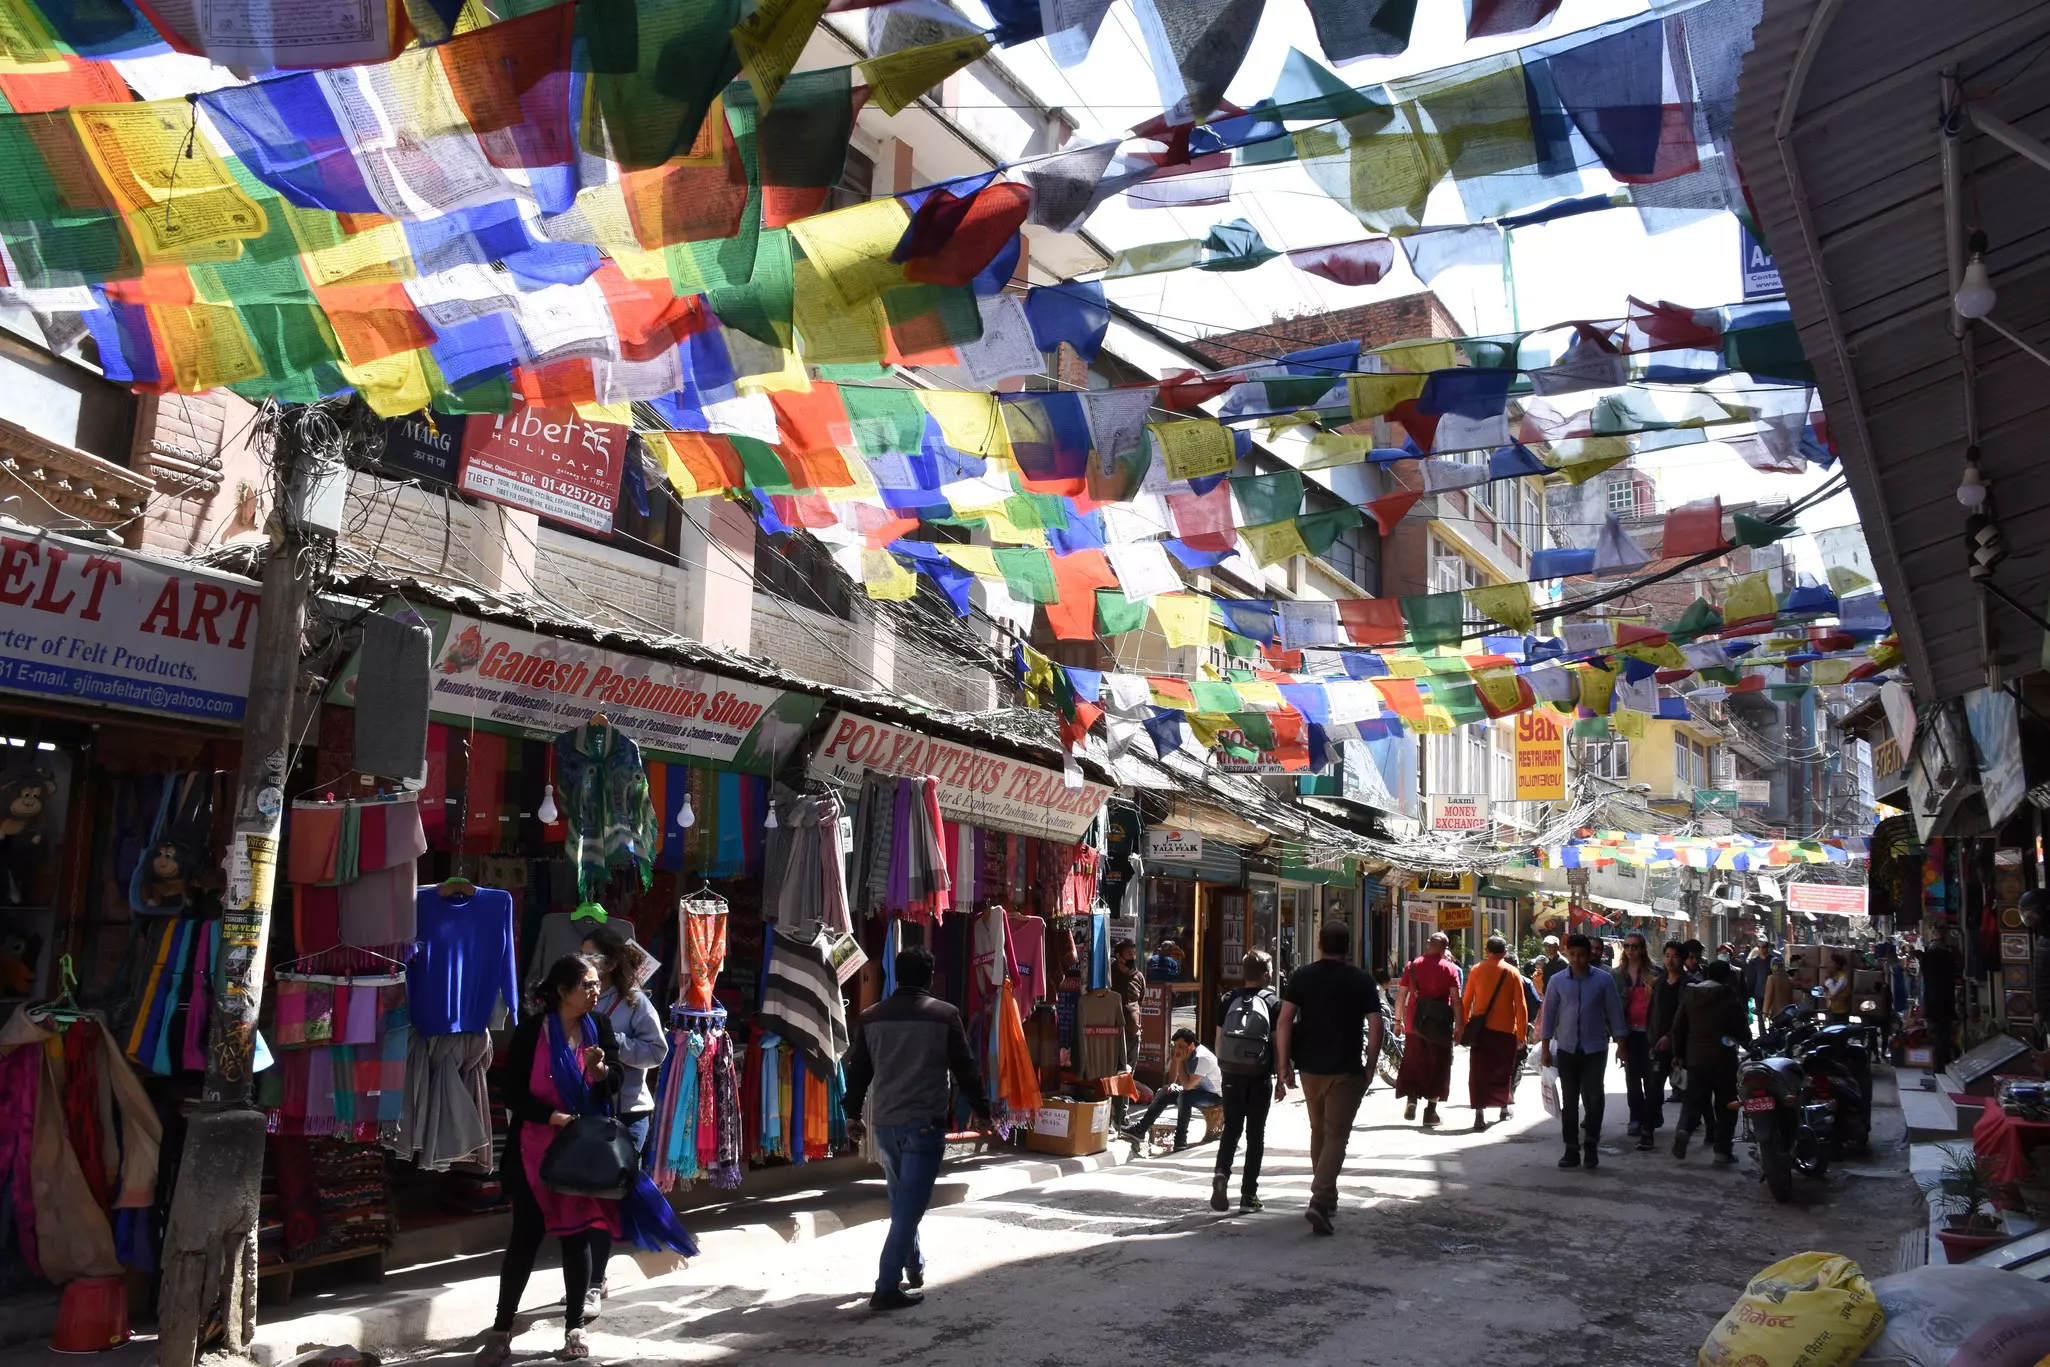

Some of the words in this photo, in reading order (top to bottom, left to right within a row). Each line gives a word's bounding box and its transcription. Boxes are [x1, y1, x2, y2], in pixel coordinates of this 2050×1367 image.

[492, 432, 604, 476] HOLIDAYS
[467, 471, 495, 487] TIBET
[521, 471, 536, 485] Tel:
[541, 476, 612, 510] 01-4257275
[140, 576, 262, 650] ART
[41, 635, 67, 656] of
[67, 638, 107, 664] Felt
[110, 646, 197, 681] Products.
[73, 675, 233, 714] ajimafeltart@yahoo.com
[478, 641, 589, 697] Ganesh
[583, 664, 707, 719] Pashmina
[703, 691, 763, 731] Shop
[434, 678, 501, 704] Manufacturer,
[554, 702, 561, 713] &
[616, 712, 638, 728] kinds
[636, 718, 648, 730] of
[645, 719, 682, 735] Pashmina
[680, 726, 688, 737] &
[687, 726, 721, 744] Cashmere
[720, 733, 742, 746] Items
[824, 717, 1007, 794] POLYANTHUS
[1002, 765, 1108, 818] TRADERS
[1518, 749, 1561, 767] RESTAURANT
[951, 792, 963, 805] &
[962, 794, 1001, 814] Exporter,
[1001, 807, 1038, 824] Pashmina,
[1038, 813, 1076, 830] Cashmere
[1435, 818, 1486, 829] EXCHANGE
[1444, 806, 1477, 817] MONEY
[1152, 844, 1174, 852] YALA
[1175, 844, 1198, 852] PEAK
[1445, 908, 1471, 920] MONEY
